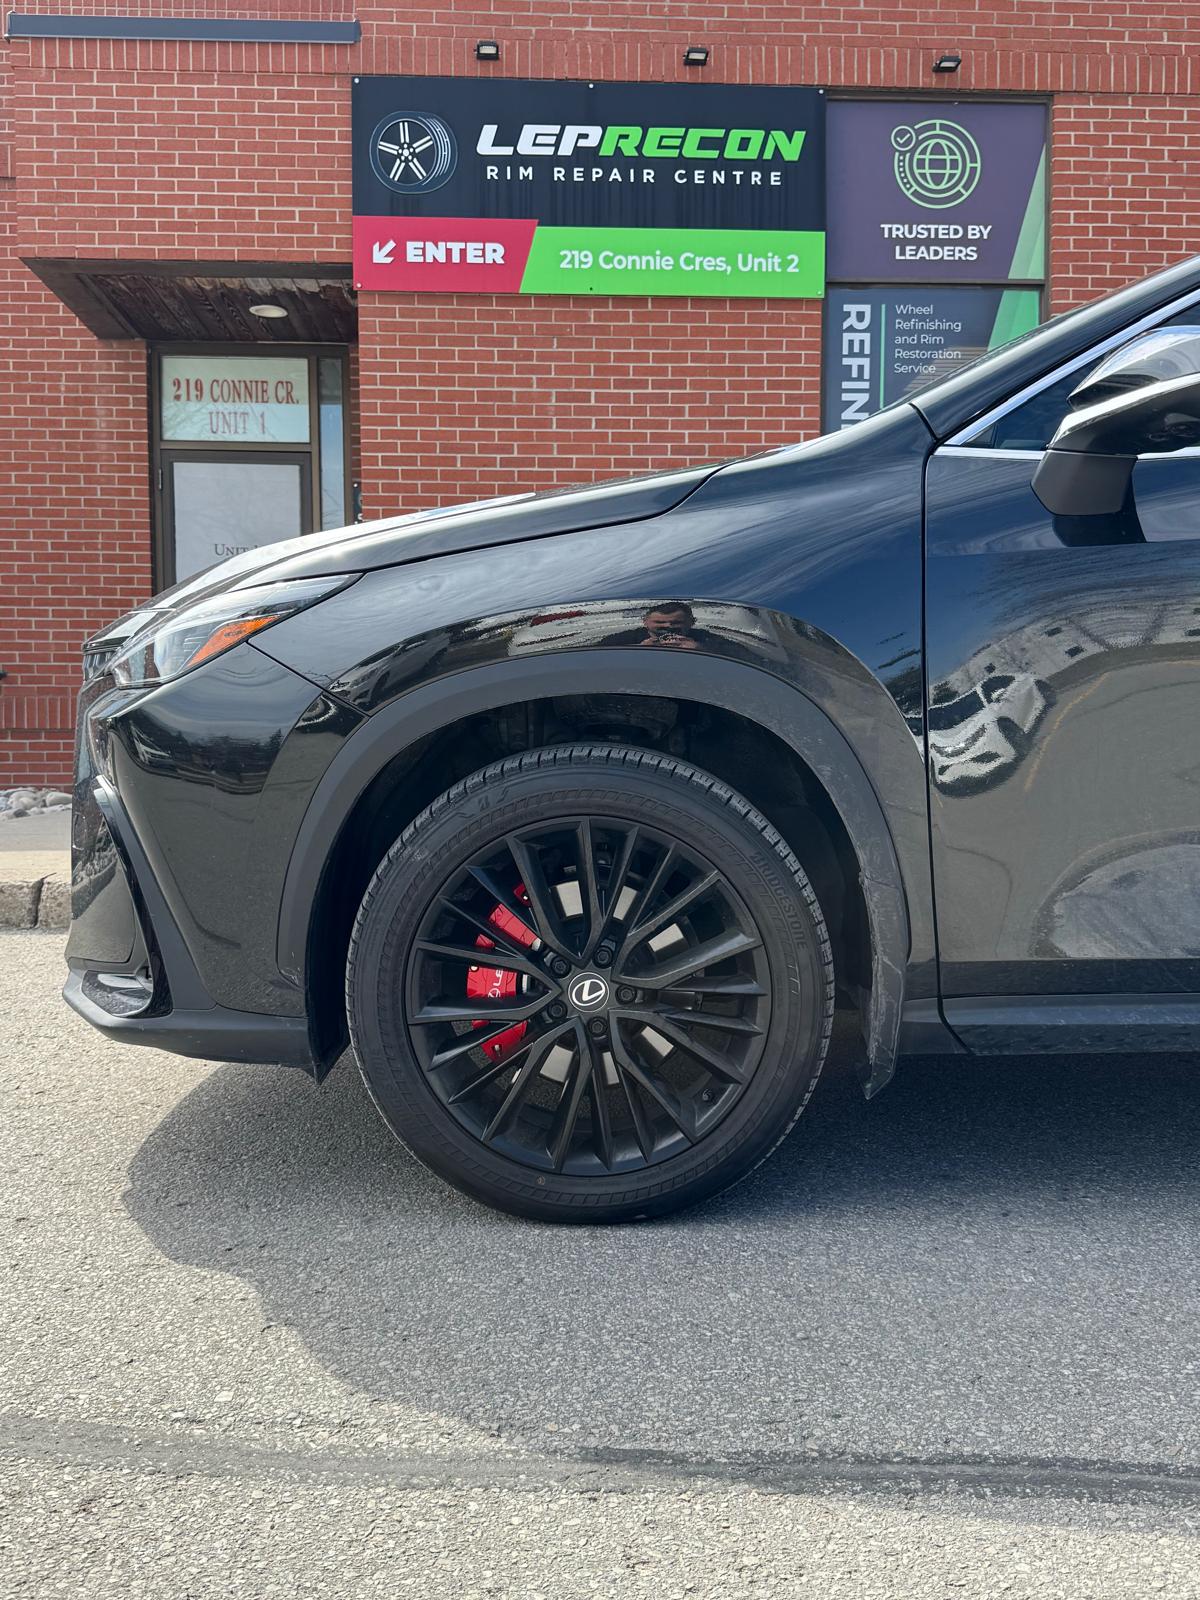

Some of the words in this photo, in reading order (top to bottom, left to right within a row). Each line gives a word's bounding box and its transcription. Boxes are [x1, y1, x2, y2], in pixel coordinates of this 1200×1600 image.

[476, 124, 807, 161] LEPRECON
[486, 166, 534, 180] RIM
[553, 168, 655, 183] REPAIR
[674, 170, 782, 186] CENTRE
[880, 224, 963, 239] TRUSTED
[967, 225, 992, 239] BY
[406, 241, 505, 264] ENTER
[895, 246, 978, 261] LEADERS
[559, 250, 593, 269] 219
[599, 250, 673, 271] Connie
[678, 252, 731, 275] Cres,
[737, 253, 782, 273] Unit
[786, 255, 799, 273] 2
[895, 304, 934, 315] Wheel
[895, 319, 962, 333] Refinishing
[894, 334, 917, 344] and
[920, 334, 944, 345] Rim
[895, 348, 961, 360] Restoration
[841, 304, 871, 430] REFIN
[894, 362, 936, 374] Service
[172, 377, 204, 402] 219
[210, 379, 270, 404] CONNIE
[275, 380, 300, 405] CR.
[209, 411, 249, 435] UNIT
[259, 411, 266, 435] 1
